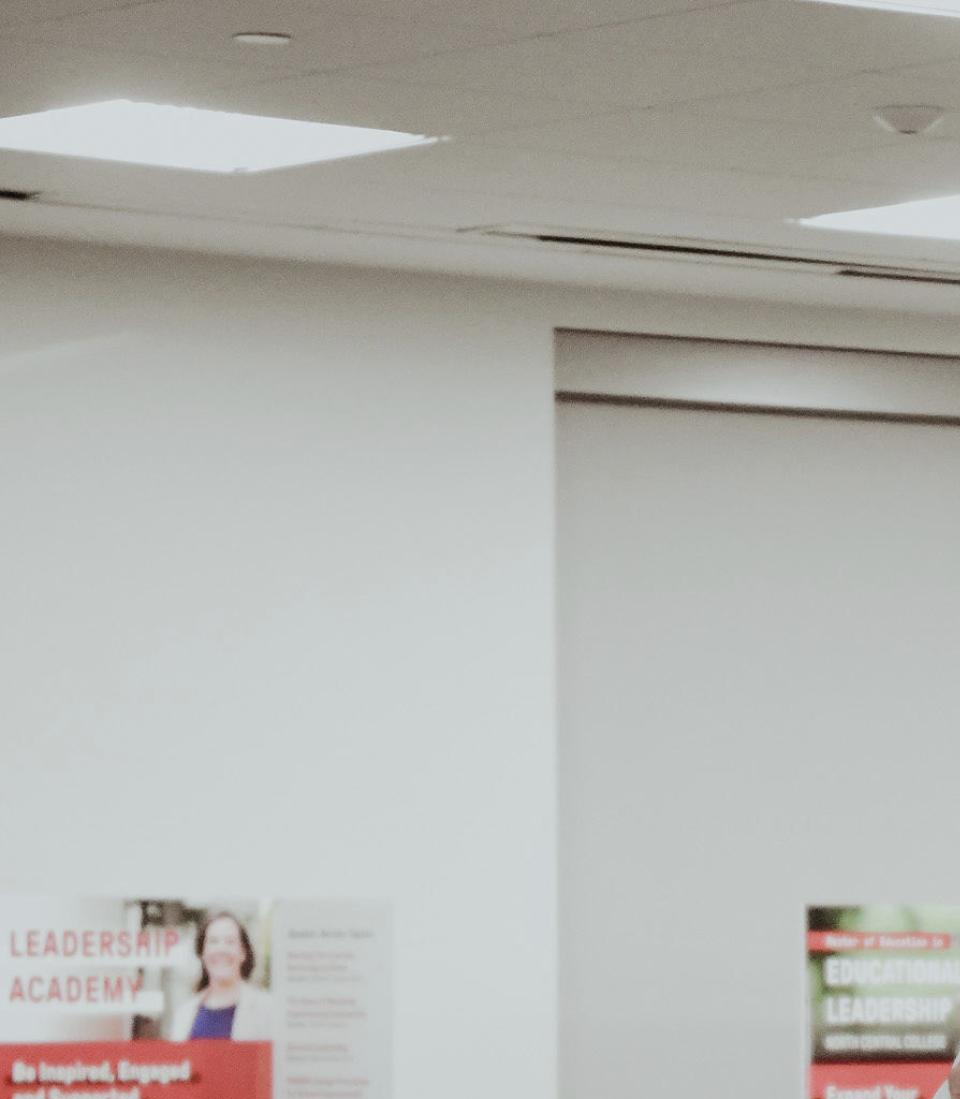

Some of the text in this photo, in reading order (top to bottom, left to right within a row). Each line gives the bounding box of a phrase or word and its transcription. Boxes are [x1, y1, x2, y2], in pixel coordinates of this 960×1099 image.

[10, 930, 180, 958] LEADERSHIP
[863, 934, 875, 947] of
[878, 934, 928, 948] Education
[9, 976, 144, 1003] ACADEMY
[825, 996, 952, 1024] LEADERSHIP
